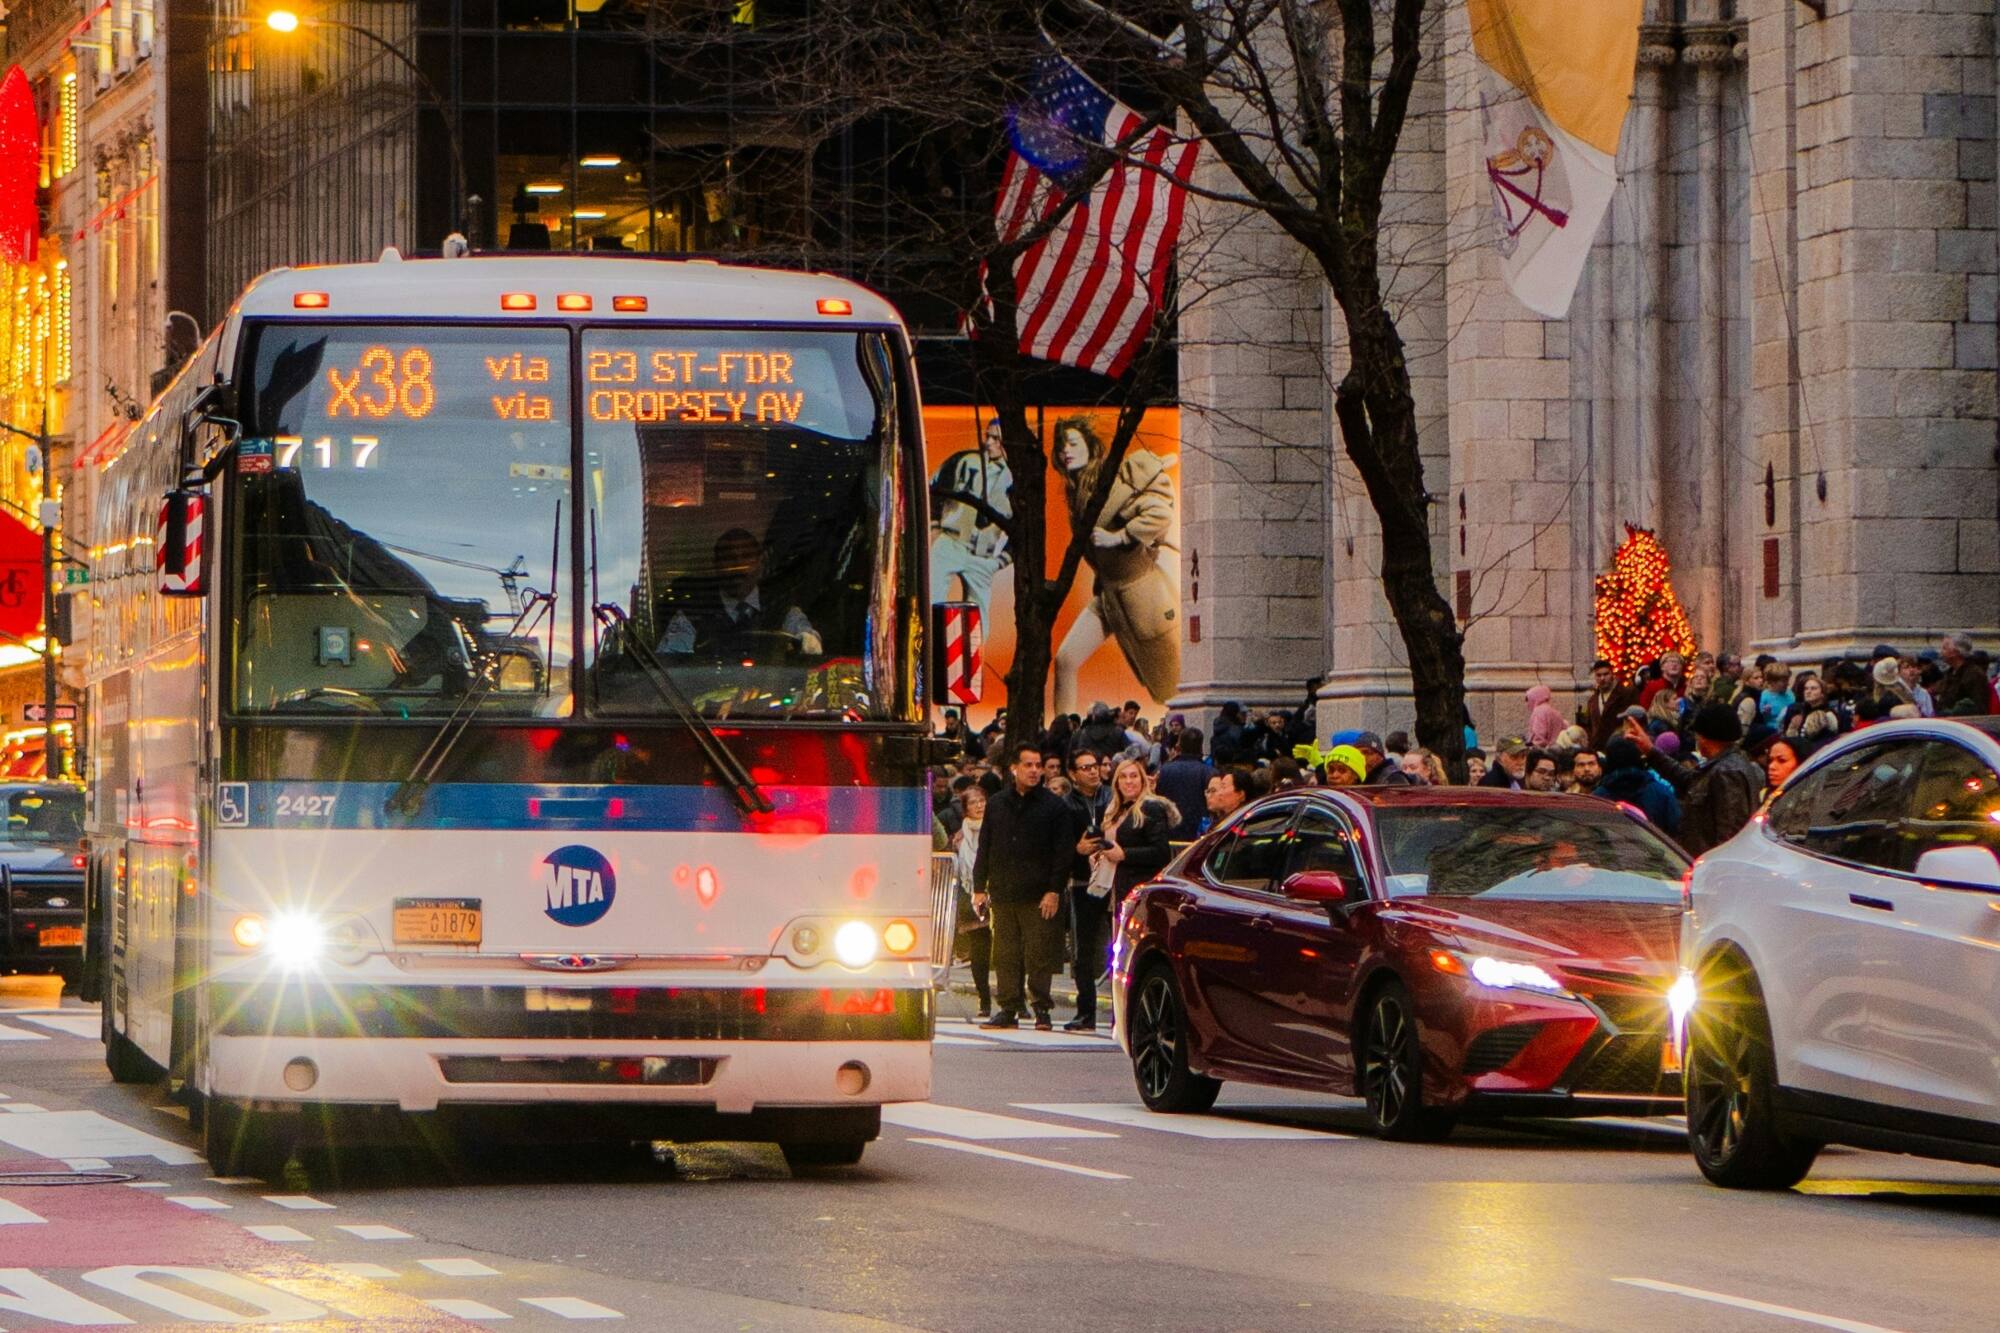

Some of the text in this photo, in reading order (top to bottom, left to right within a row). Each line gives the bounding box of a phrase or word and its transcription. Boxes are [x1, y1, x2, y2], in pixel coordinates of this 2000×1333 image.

[485, 352, 794, 384] via 23 ST-FDR
[493, 391, 803, 422] via CROPSEY AV
[276, 795, 336, 816] 2427
[544, 863, 604, 911] MTA
